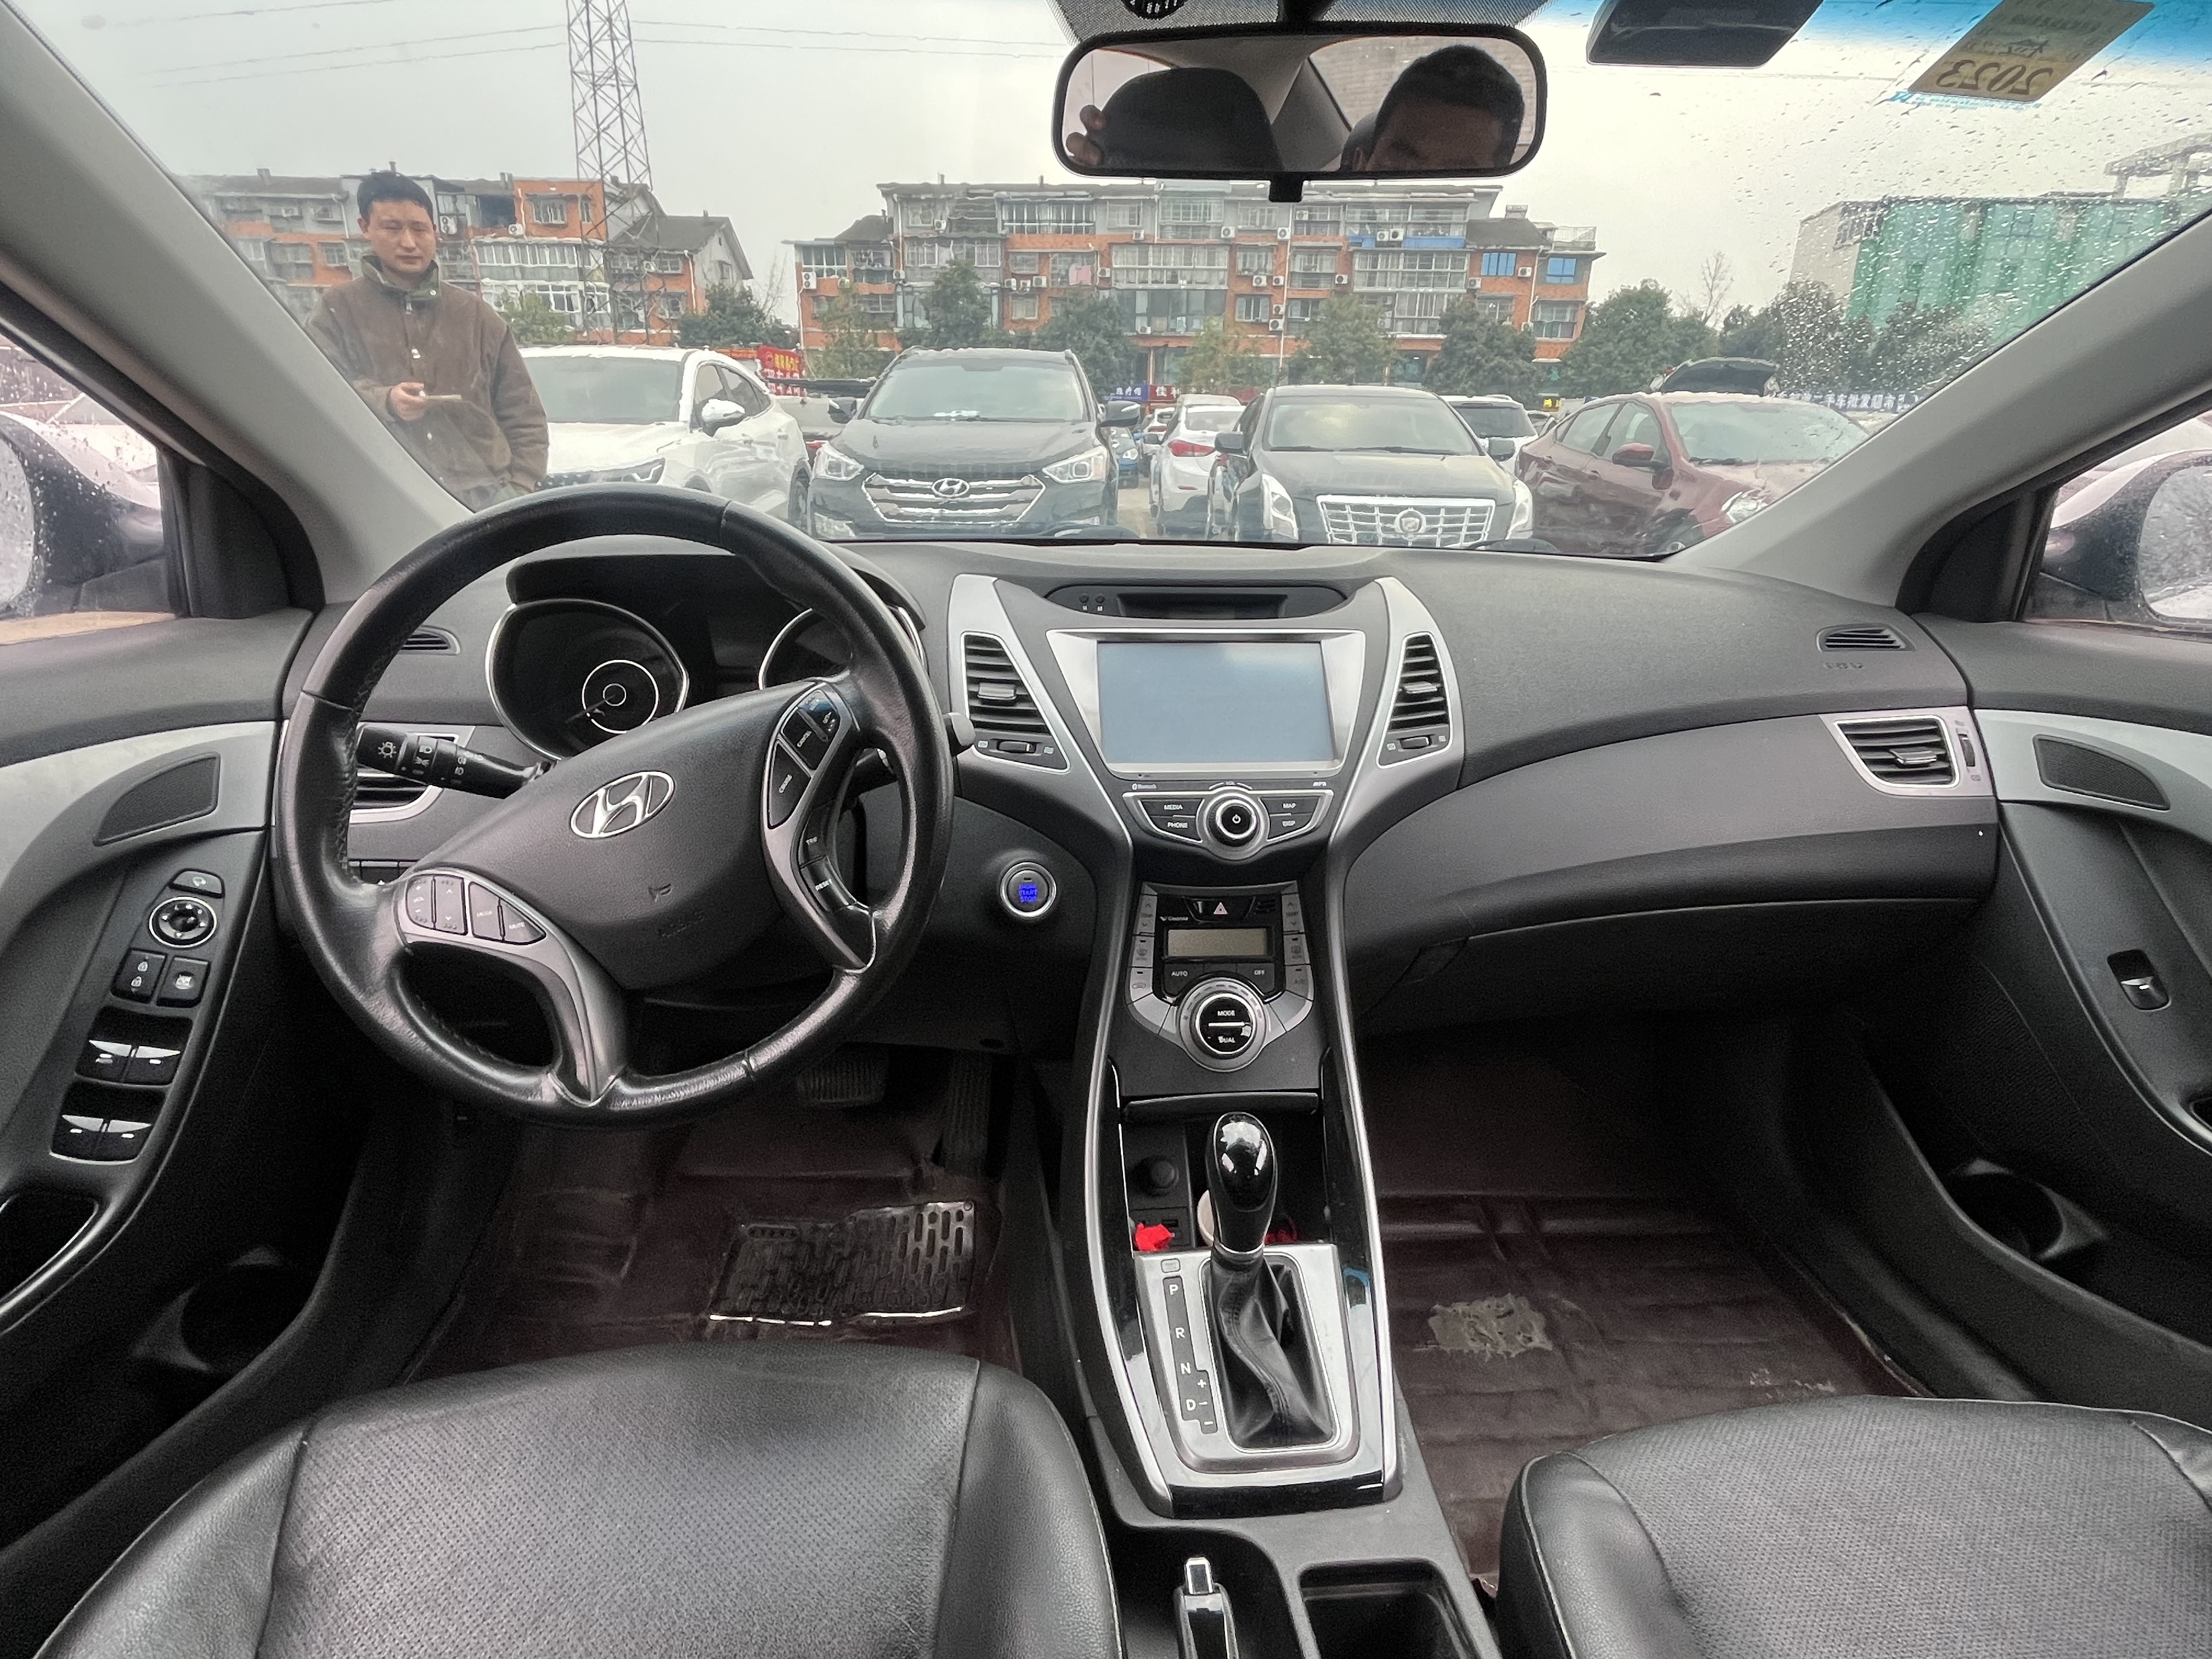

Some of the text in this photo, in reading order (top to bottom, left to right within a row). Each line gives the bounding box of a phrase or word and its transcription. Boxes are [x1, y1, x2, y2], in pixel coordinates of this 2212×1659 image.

[1169, 1284, 1178, 1295] P
[1175, 1327, 1185, 1339] R
[1181, 1362, 1191, 1374] N
[1186, 1399, 1196, 1412] D
